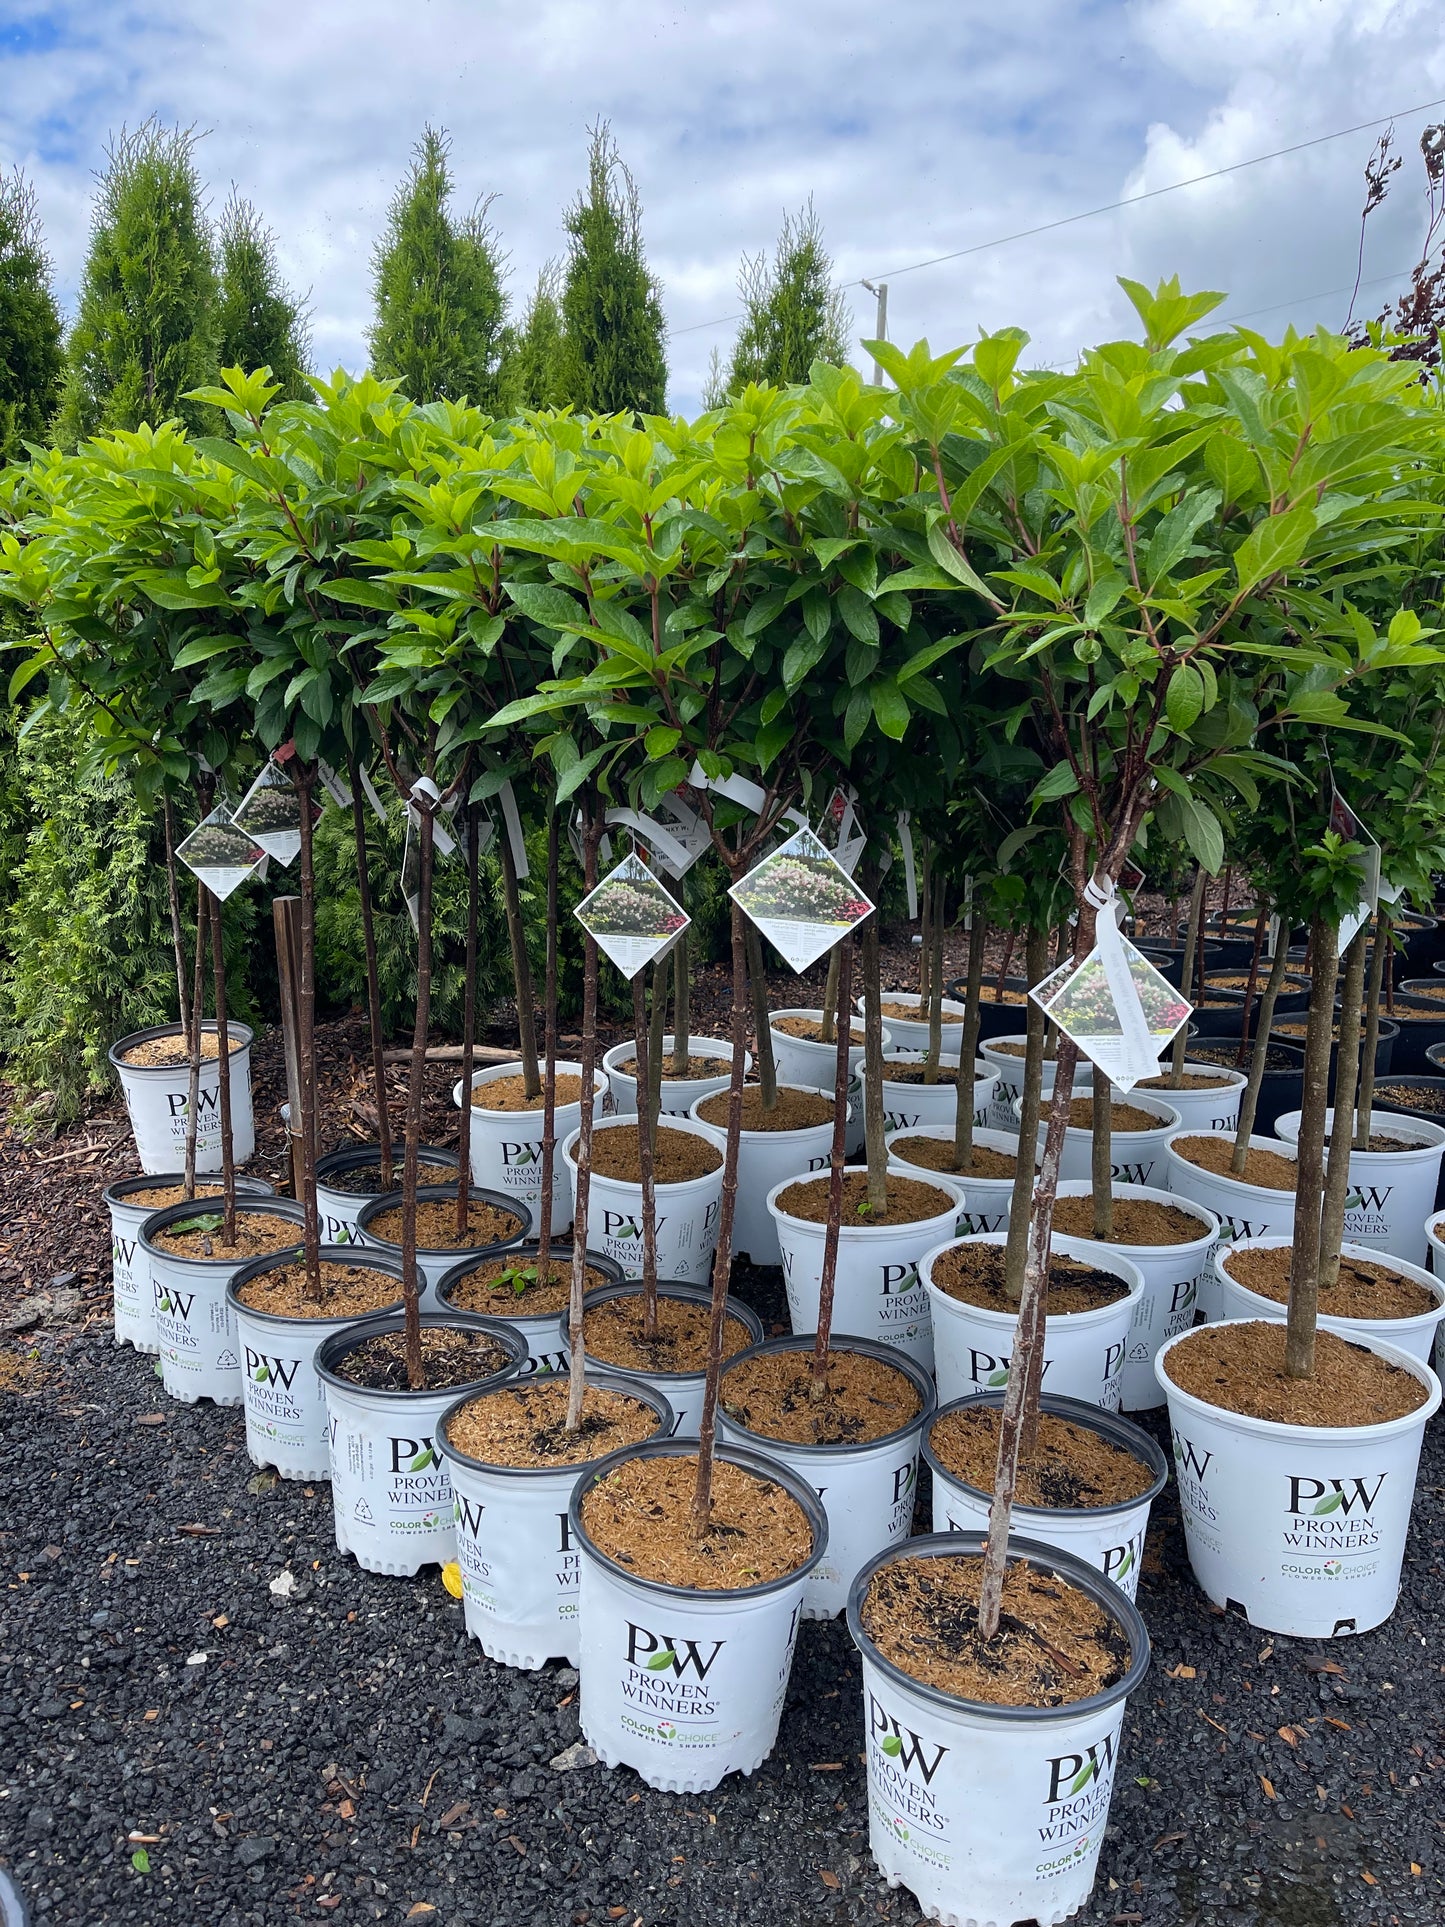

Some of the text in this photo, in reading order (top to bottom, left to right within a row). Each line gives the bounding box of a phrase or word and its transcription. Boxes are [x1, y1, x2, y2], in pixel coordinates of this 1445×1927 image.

[170, 1120, 222, 1136] WINERS
[173, 1112, 219, 1126] PRVEN
[884, 1111, 921, 1130] W
[503, 1173, 560, 1185] WINNES
[507, 1167, 543, 1176] PROVE
[1346, 1186, 1394, 1211] W
[1344, 1213, 1384, 1223] OVEN
[1343, 1223, 1390, 1233] NNERS
[602, 1246, 665, 1262] WINNES
[606, 1238, 658, 1252] PROV
[153, 1279, 196, 1320] PW
[886, 1291, 929, 1308] PROVE
[878, 1302, 930, 1320] WINNE
[244, 1344, 302, 1391] PW
[249, 1381, 294, 1406] PROVEN
[394, 1473, 449, 1490] PROVE
[387, 1487, 452, 1505] WINNE
[1284, 1472, 1389, 1516] PW
[455, 1488, 485, 1540] W
[390, 1521, 421, 1529] COLOR
[1293, 1517, 1375, 1534] PROVEN
[1281, 1562, 1379, 1575] COLOR CHOICE
[1281, 1570, 1377, 1581] FLOWERING SHRUBS
[558, 1605, 579, 1613] COL
[623, 1619, 727, 1682] PW
[628, 1668, 710, 1699] PROVEN
[620, 1715, 719, 1742] COLOR CHOICE
[621, 1725, 673, 1747] FLOWERING
[868, 1688, 951, 1786] PW
[1042, 1720, 1121, 1805] PW
[872, 1745, 937, 1809] PROVEN
[909, 1837, 952, 1864] CHOICE
[912, 1849, 951, 1872] SHRUBS
[1036, 1853, 1072, 1873] COLOR
[1036, 1856, 1086, 1881] FLOWERING
